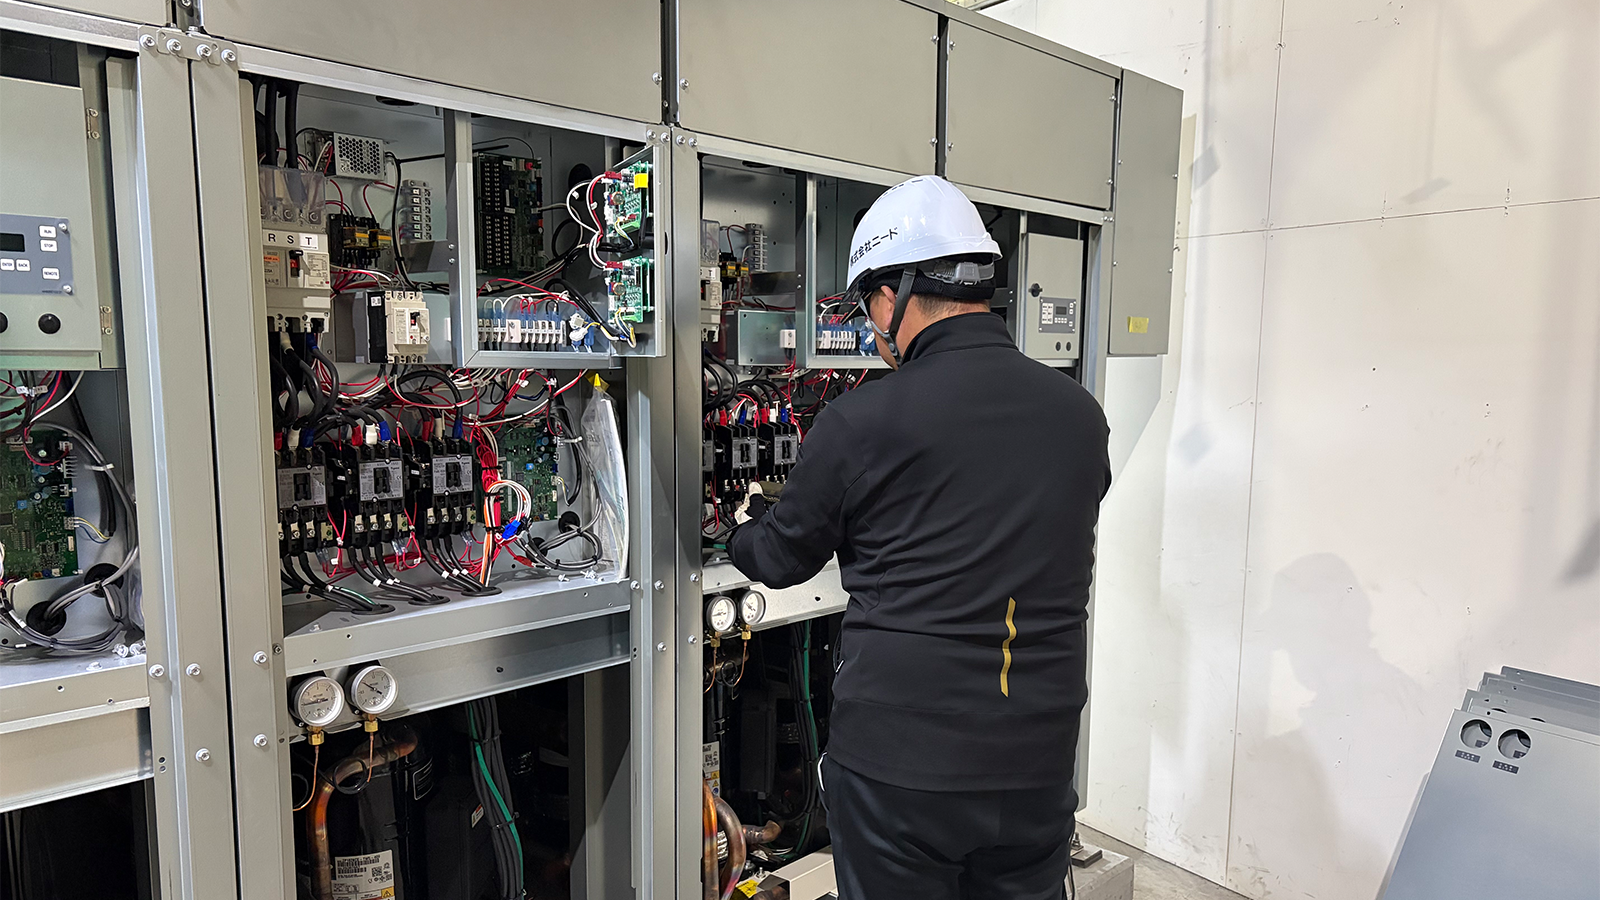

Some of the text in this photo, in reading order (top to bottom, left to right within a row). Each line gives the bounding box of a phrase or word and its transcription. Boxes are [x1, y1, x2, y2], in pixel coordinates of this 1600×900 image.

[268, 233, 312, 245] R S T
